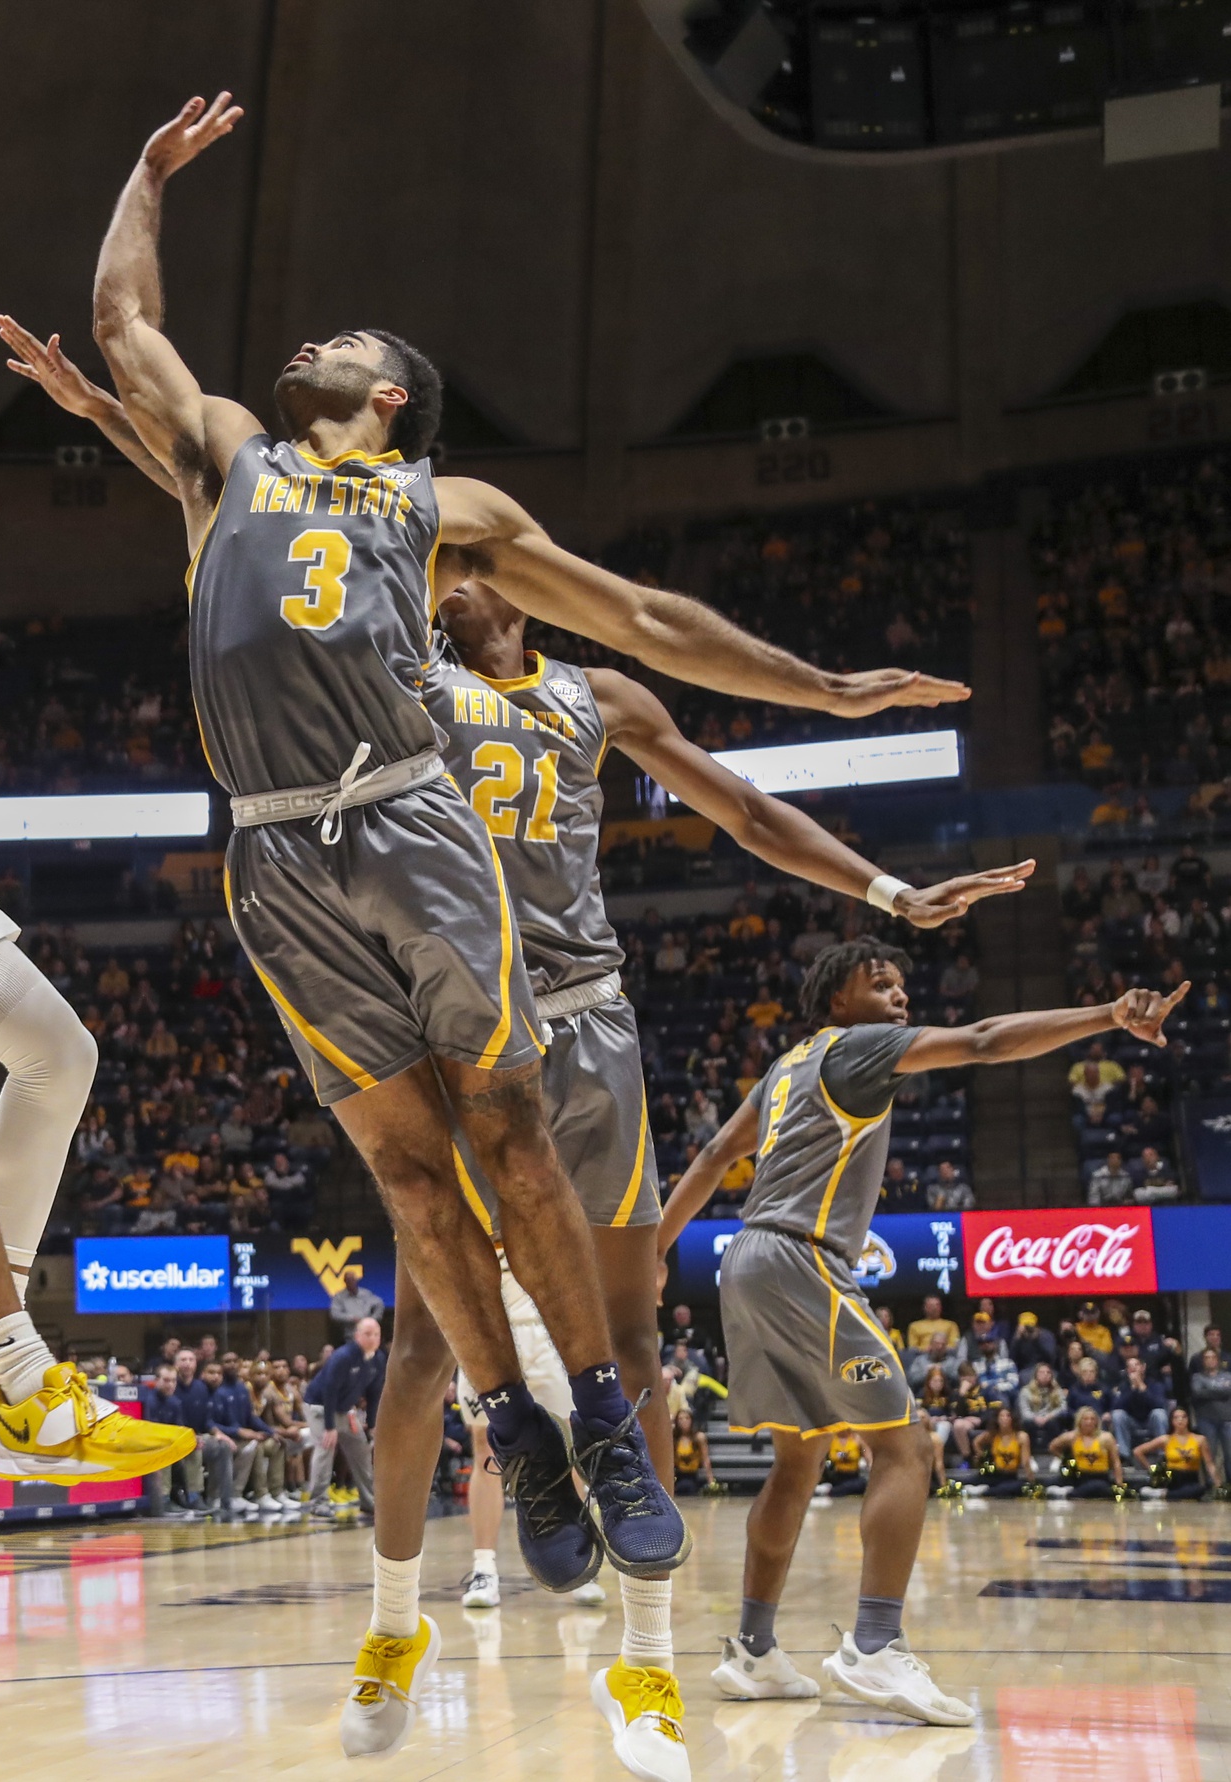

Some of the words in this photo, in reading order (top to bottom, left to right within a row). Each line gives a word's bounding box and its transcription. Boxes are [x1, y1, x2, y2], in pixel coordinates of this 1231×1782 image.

[756, 449, 831, 485] 220
[250, 473, 323, 515] KENT
[328, 475, 413, 527] STATE
[280, 529, 353, 631] 3
[452, 685, 510, 728] KENT
[521, 709, 576, 744] STATE
[470, 740, 560, 843] 21
[759, 1073, 791, 1158] 2
[930, 1221, 956, 1235] TOL
[233, 1243, 256, 1255] TOL
[937, 1231, 950, 1257] 2
[974, 1223, 1139, 1280] Coca-Cola
[110, 1262, 224, 1290] uscellular
[238, 1253, 250, 1275] 3
[918, 1257, 958, 1271] FOULS
[233, 1275, 269, 1288] FOULS
[937, 1268, 951, 1294] 4
[242, 1286, 254, 1309] 2
